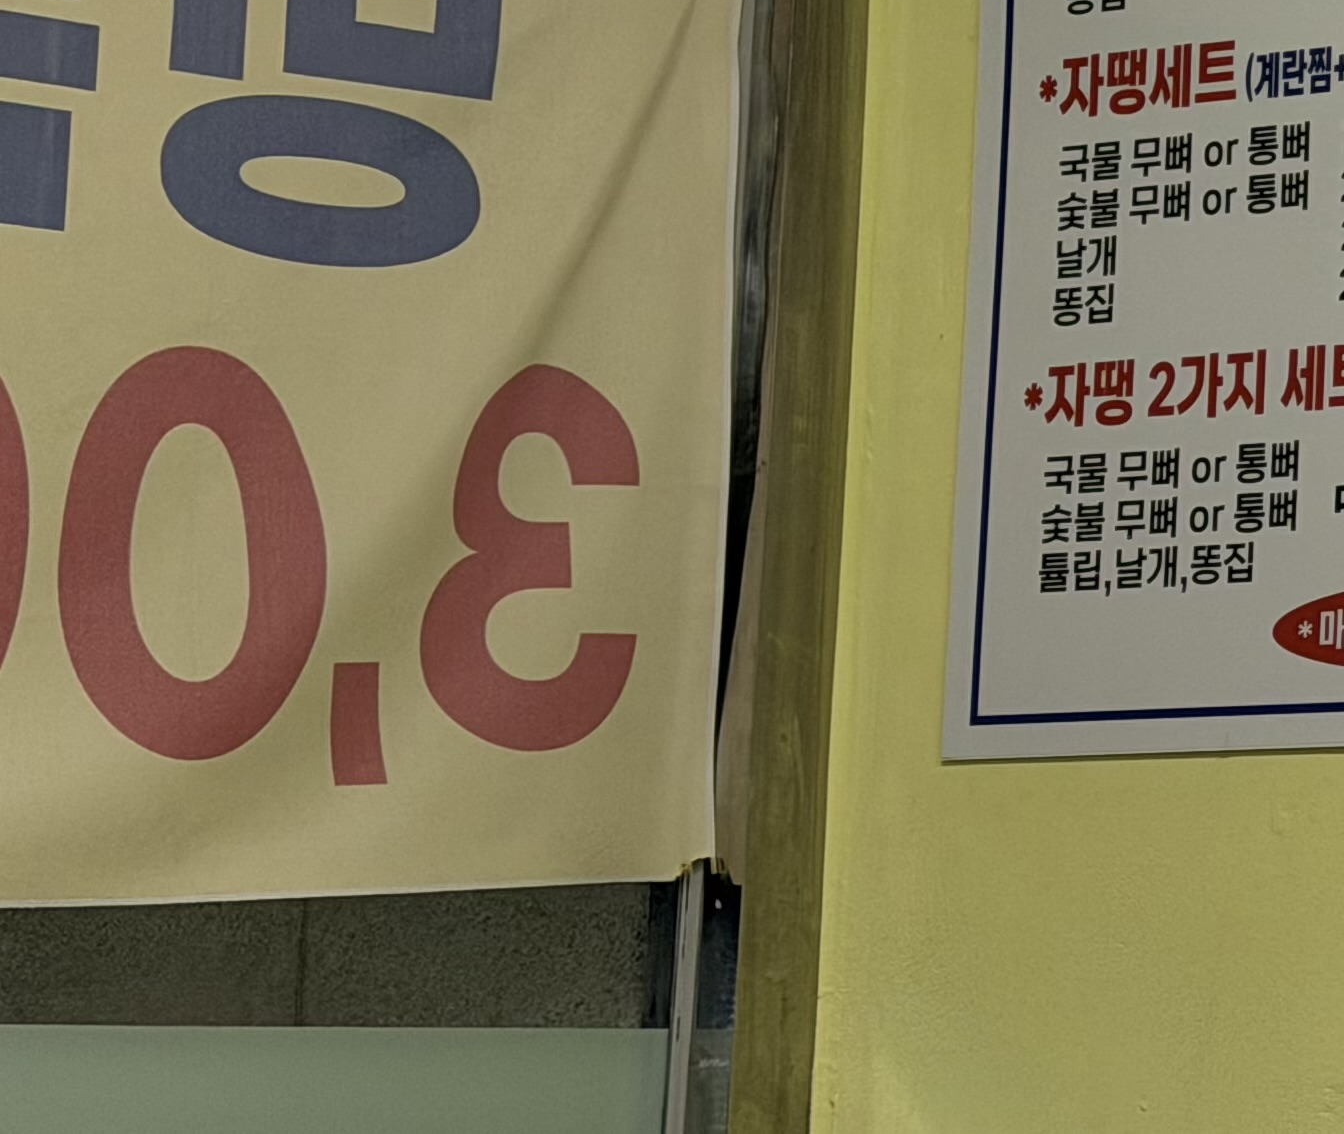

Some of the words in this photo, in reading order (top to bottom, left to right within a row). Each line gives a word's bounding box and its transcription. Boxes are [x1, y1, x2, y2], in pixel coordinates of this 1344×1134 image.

[1060, 141, 1121, 182] 국물
[1131, 133, 1192, 177] 무뼈
[1205, 139, 1239, 167] or
[1248, 121, 1310, 165] 통뼈
[1058, 188, 1119, 231] 숯불
[1129, 181, 1191, 224] 무뼈
[1203, 187, 1237, 215] or
[1246, 170, 1309, 214] 통뼈
[1057, 235, 1116, 279] 날개
[1053, 283, 1114, 326] 똥집
[1148, 349, 1266, 418] 2가지
[1044, 453, 1107, 494] 국물
[1117, 448, 1180, 491] 무뼈
[1192, 456, 1227, 483] or
[1236, 440, 1299, 483] 통뼈
[1042, 502, 1105, 544] 숯불
[1115, 497, 1178, 540] 무뼈
[1190, 505, 1225, 532] or
[1234, 490, 1297, 533] 통뼈
